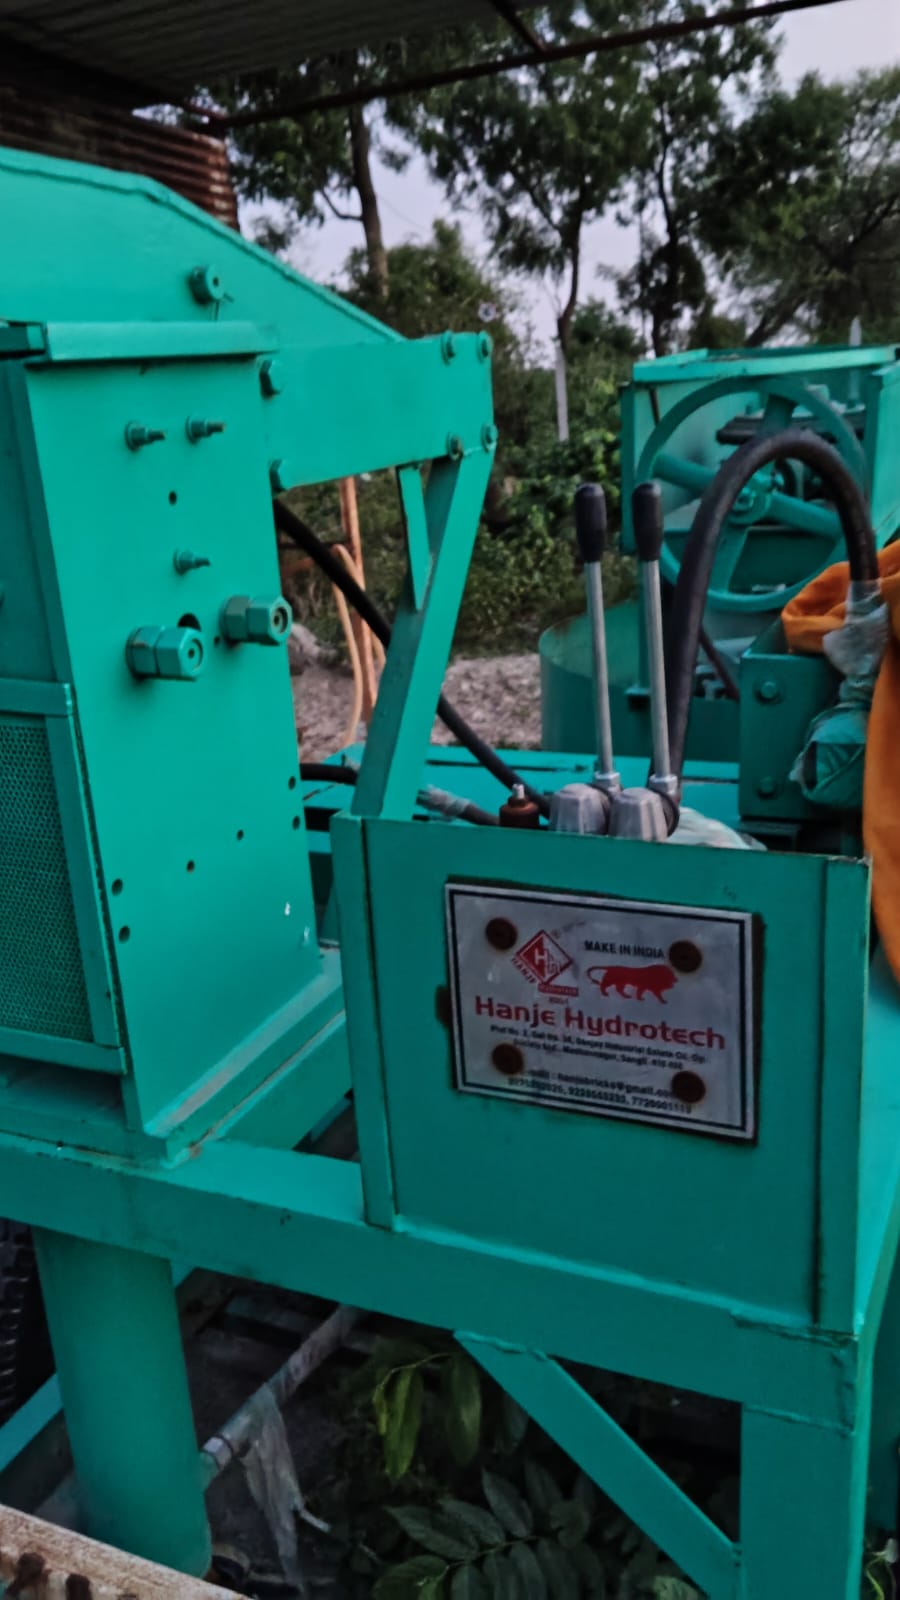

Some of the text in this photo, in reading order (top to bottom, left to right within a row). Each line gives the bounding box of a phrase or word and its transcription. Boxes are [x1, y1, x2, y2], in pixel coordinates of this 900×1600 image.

[584, 940, 665, 959] MAKE IN INDIA
[475, 995, 726, 1050] Hanje Hydrotech
